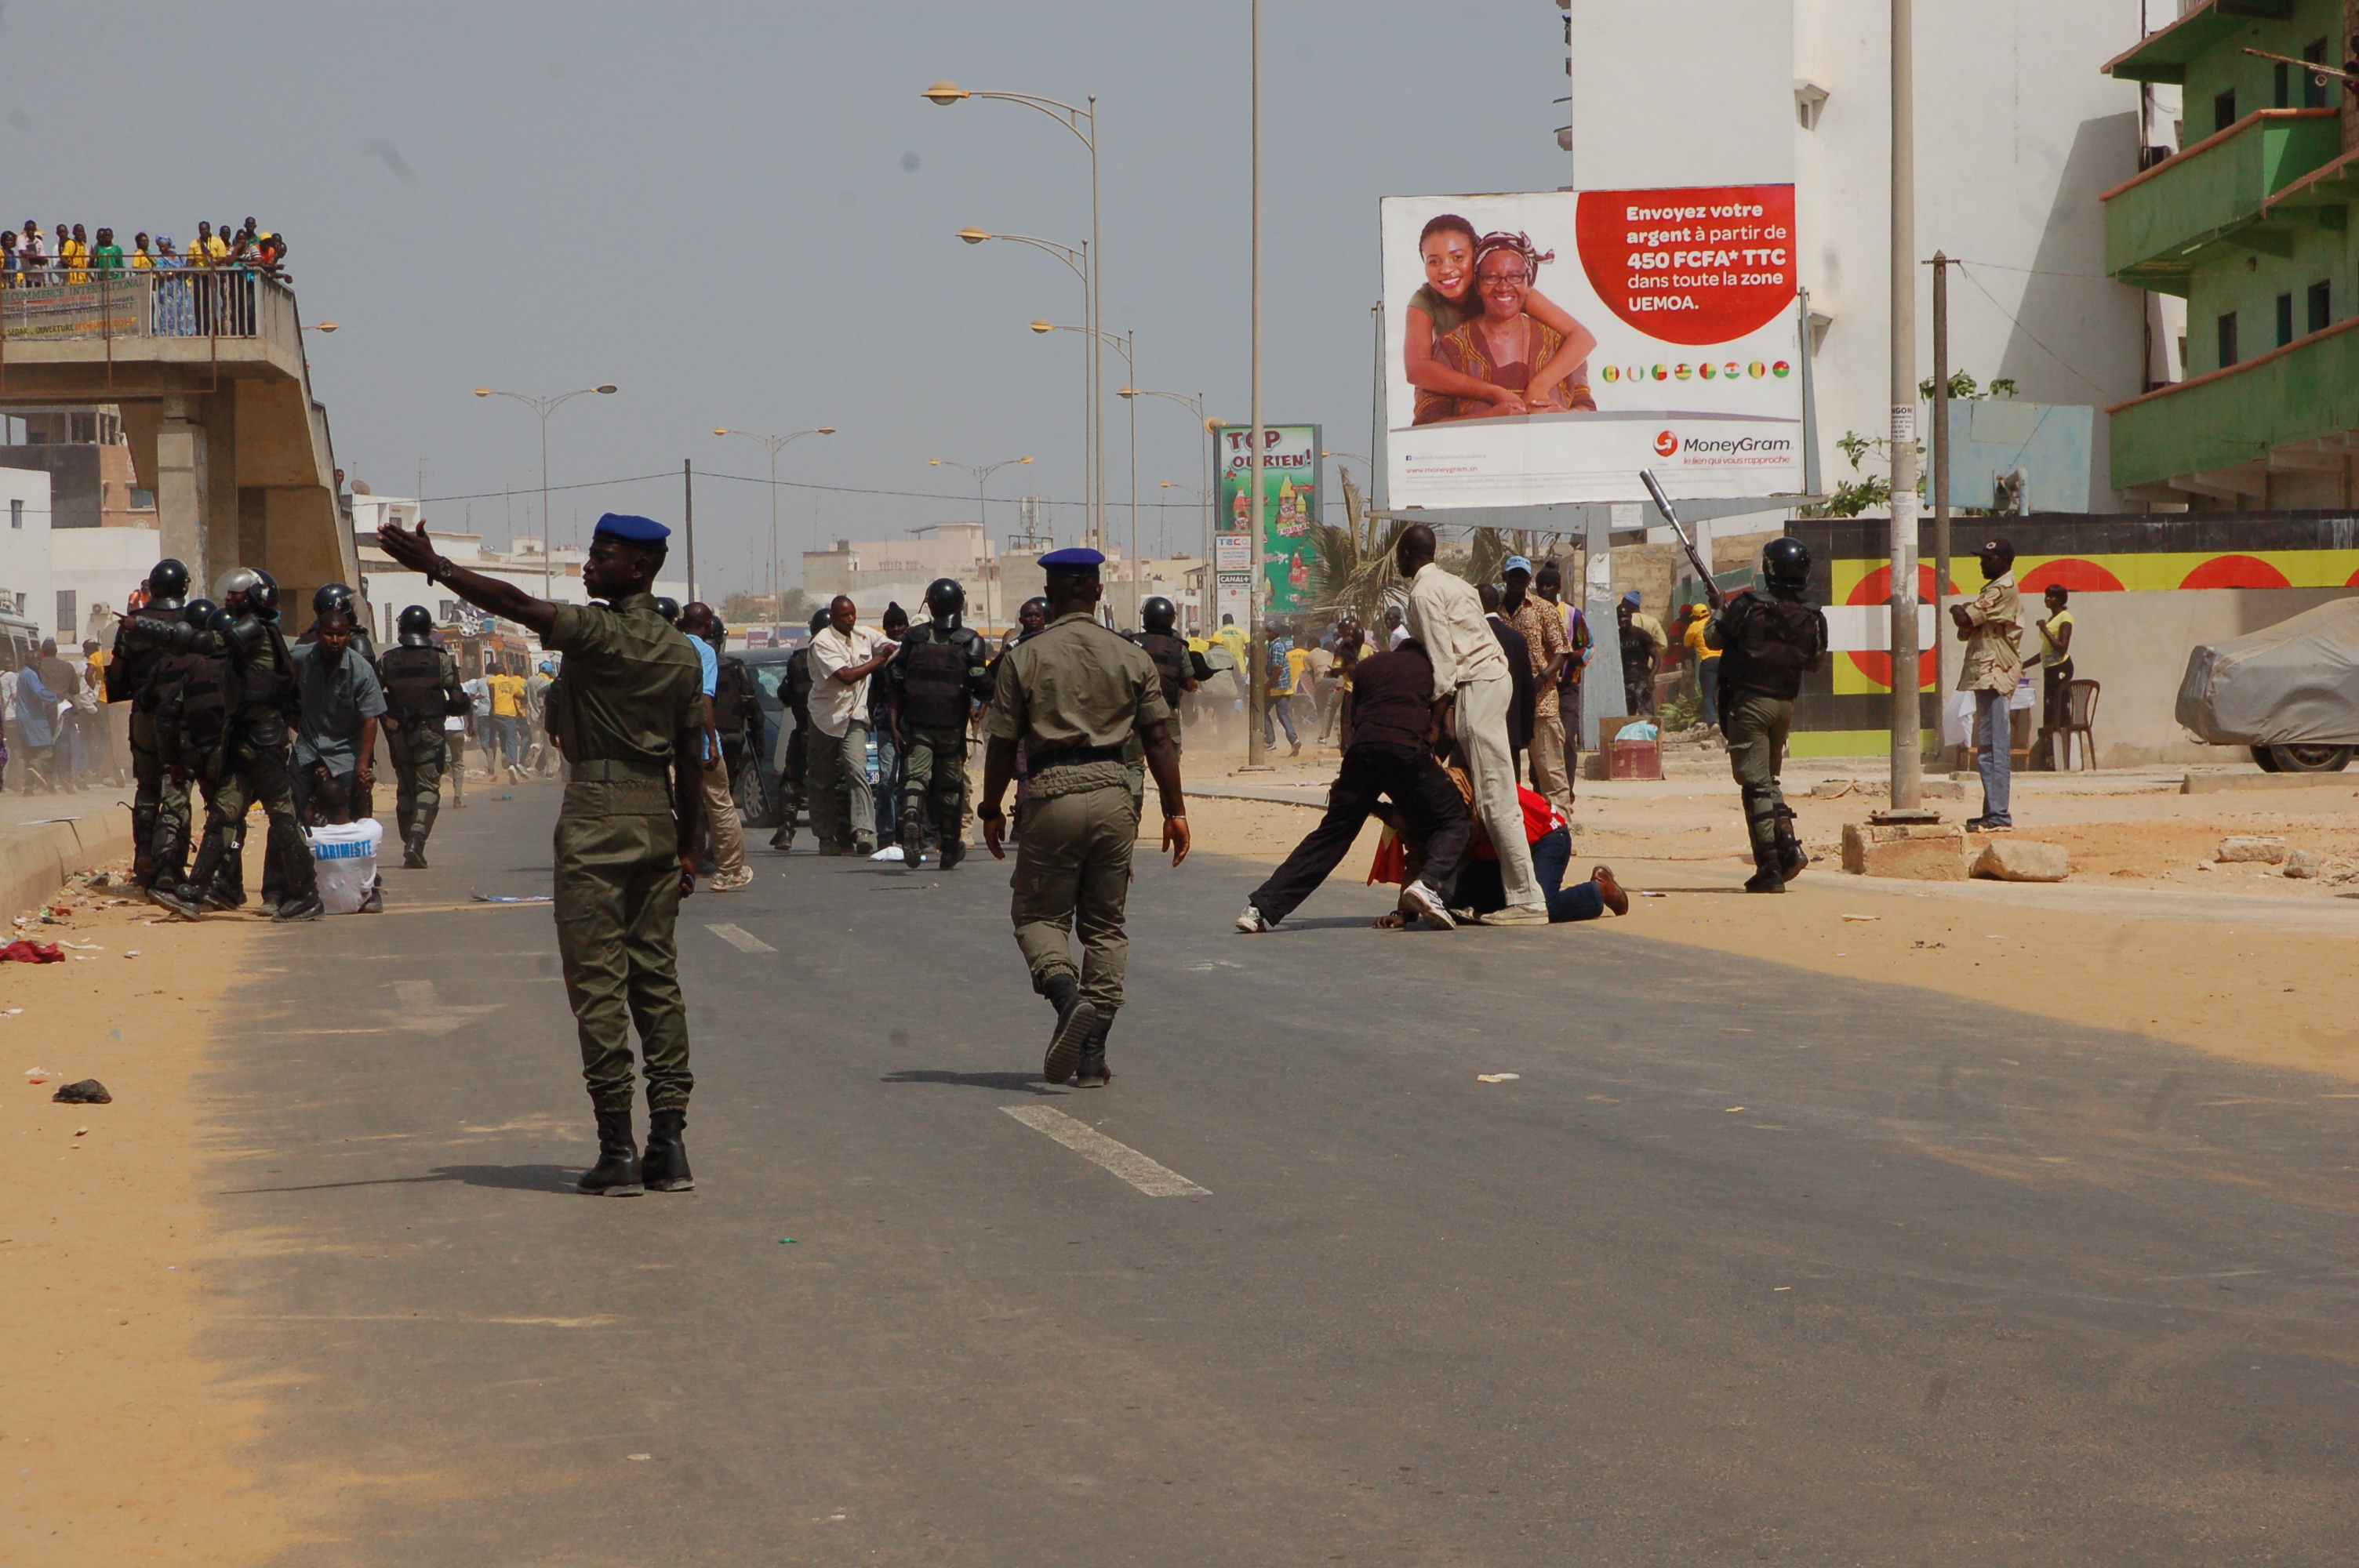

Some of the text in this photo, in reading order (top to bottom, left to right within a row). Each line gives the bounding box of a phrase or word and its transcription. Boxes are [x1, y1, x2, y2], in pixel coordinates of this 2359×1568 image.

[1627, 203, 1764, 222] Envoyez votre
[1627, 225, 1787, 247] argent à partir de
[1627, 252, 1670, 269] 450
[1742, 249, 1787, 266] TTC
[1628, 271, 1784, 289] dans toute la zone
[11, 288, 64, 300] COMMERCE
[1628, 296, 1699, 312] UEMOA.
[1684, 437, 1790, 456] MoneyGram
[1708, 456, 1722, 466] qui
[1744, 456, 1790, 466] rapproche
[314, 839, 373, 861] KARIMISTE
